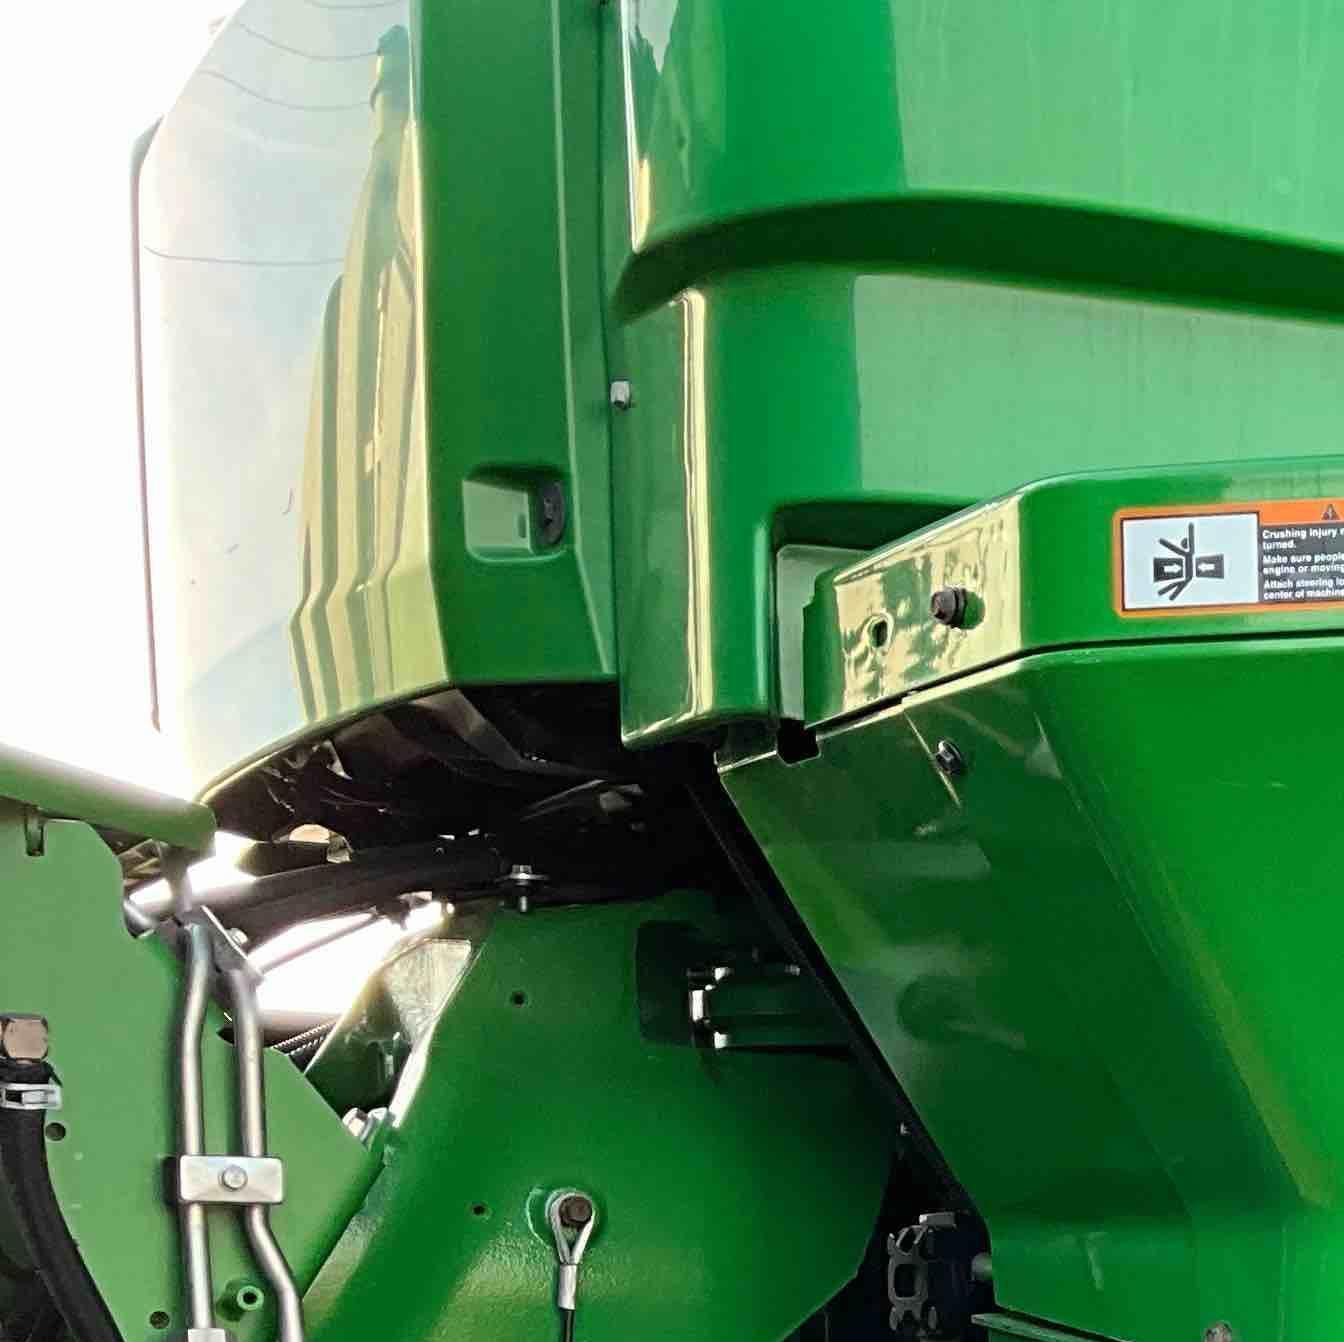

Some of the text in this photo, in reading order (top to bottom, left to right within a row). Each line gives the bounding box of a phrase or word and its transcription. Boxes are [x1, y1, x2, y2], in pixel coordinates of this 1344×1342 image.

[1262, 527, 1307, 540] Crushing
[1309, 526, 1339, 538] injury
[1262, 540, 1297, 550] turned.
[1263, 554, 1288, 564] Make
[1290, 554, 1312, 563] sure
[1263, 565, 1296, 577] engine
[1298, 564, 1309, 573] or
[1264, 578, 1293, 589] Attach
[1295, 576, 1334, 588] steering
[1263, 590, 1293, 600] center
[1295, 589, 1305, 599] of
[1306, 586, 1344, 598] machine
